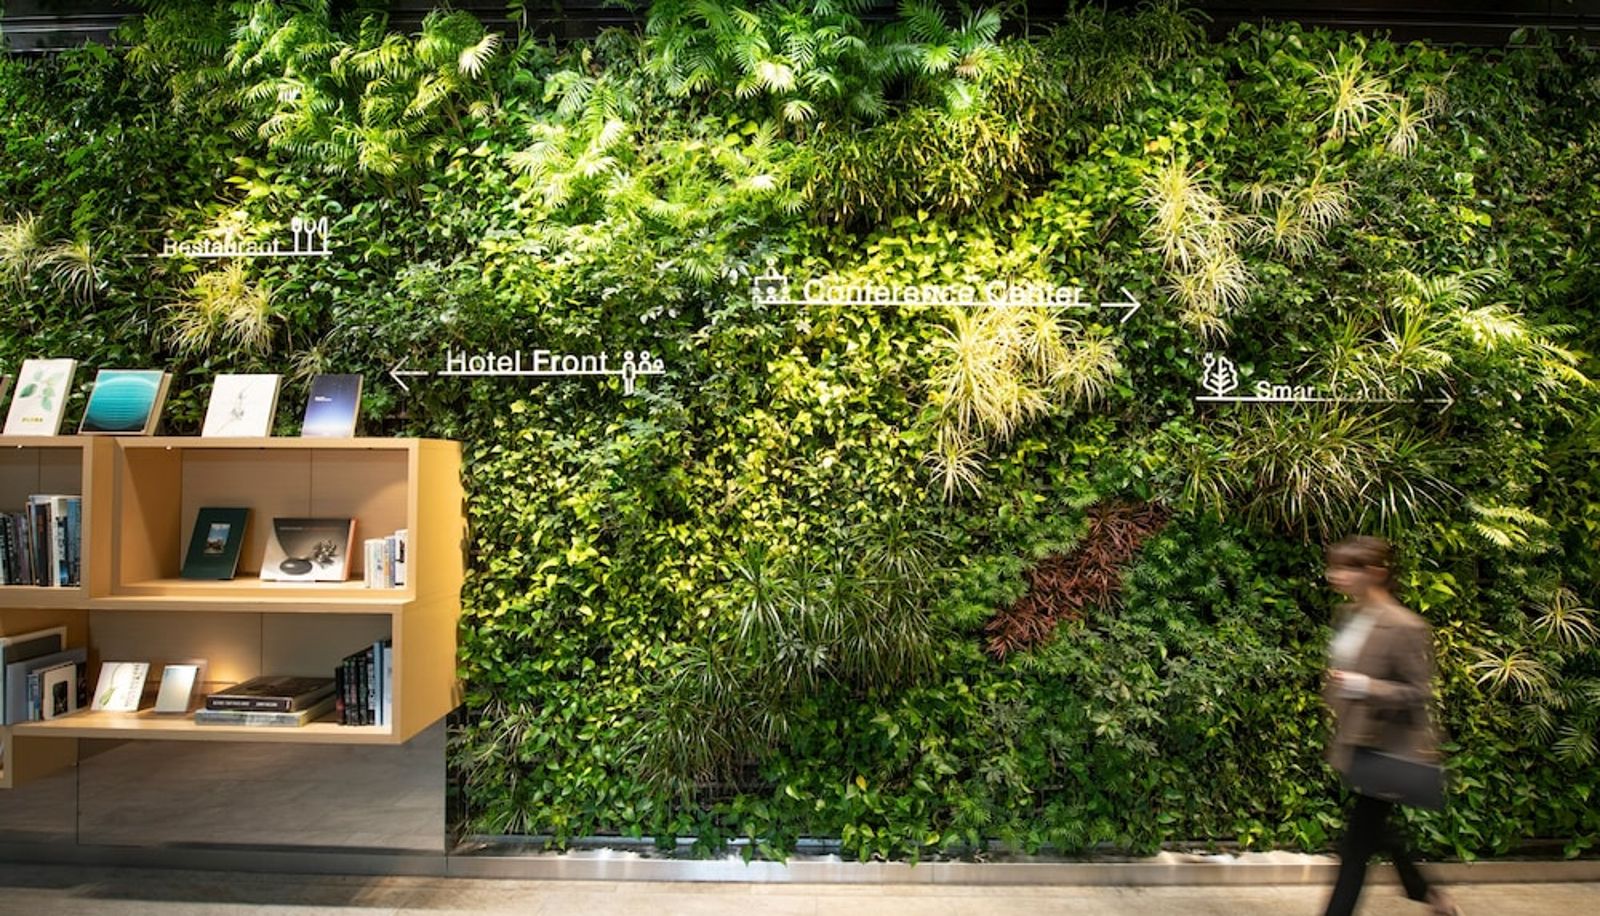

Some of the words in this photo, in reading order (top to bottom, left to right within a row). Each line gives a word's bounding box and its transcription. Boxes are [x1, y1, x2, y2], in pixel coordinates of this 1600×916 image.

[802, 278, 976, 302] Conference
[985, 279, 1084, 303] Center
[447, 349, 521, 371] Hotel
[533, 349, 609, 371] Front
[1256, 380, 1322, 399] Smar
